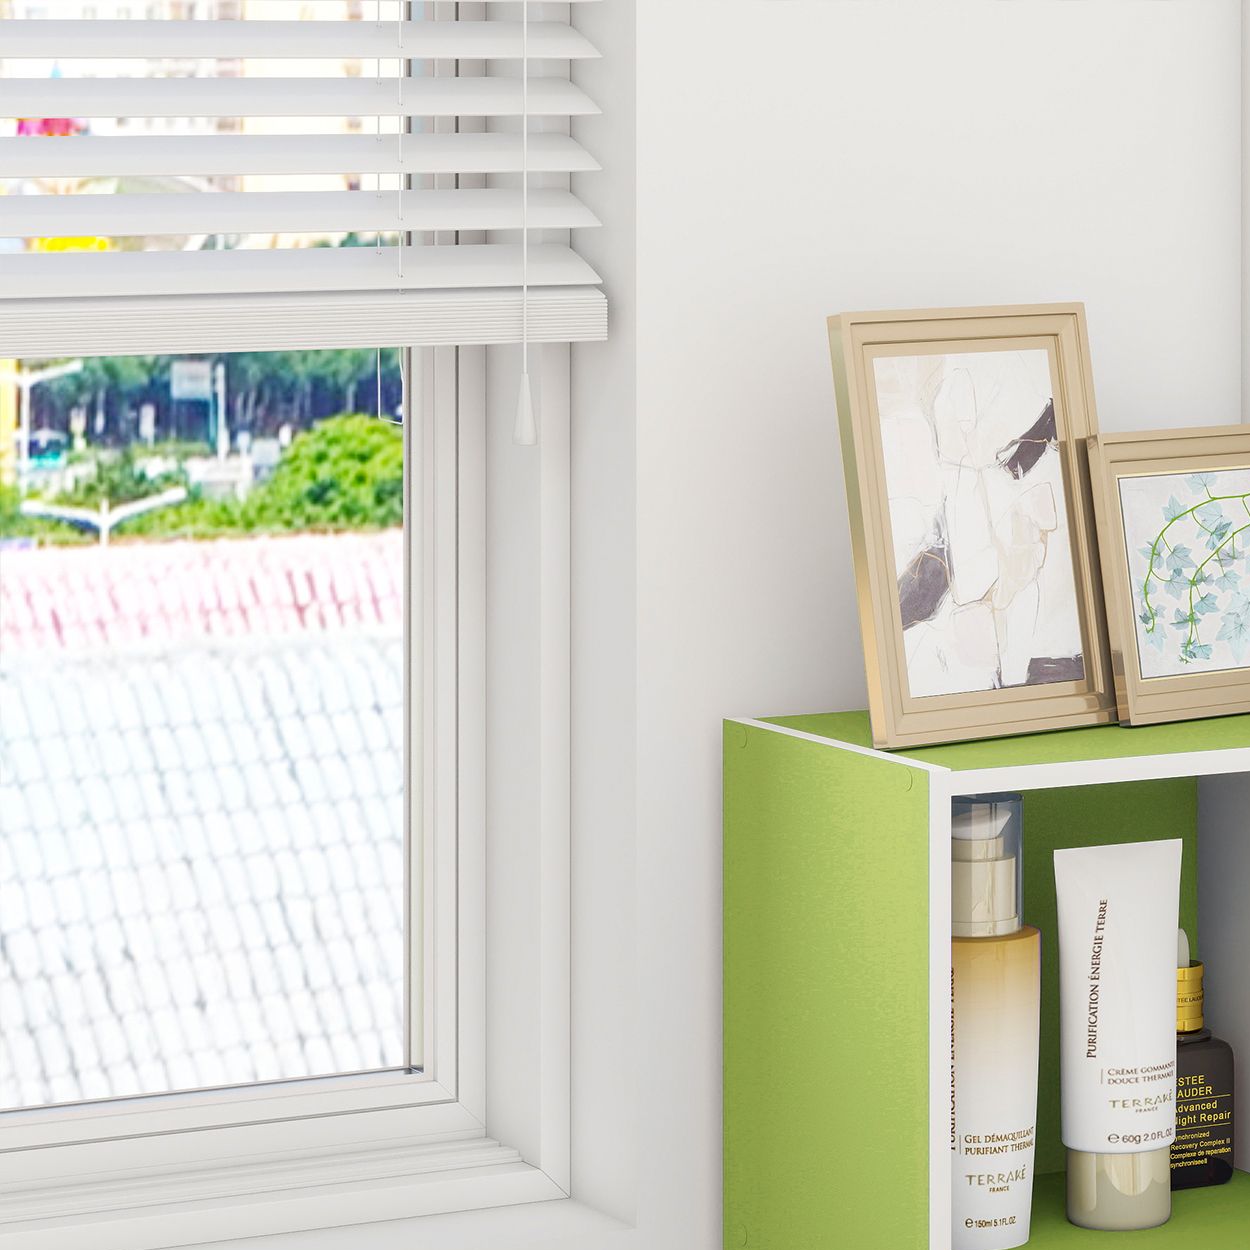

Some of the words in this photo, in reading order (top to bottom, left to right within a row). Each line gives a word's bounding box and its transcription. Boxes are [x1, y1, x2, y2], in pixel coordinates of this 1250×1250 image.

[1095, 899, 1108, 933] TERRE
[1088, 935, 1104, 980] ÉNERGIE
[1086, 984, 1099, 1058] PURIFICATION
[1107, 1077, 1139, 1085] DOUCE
[1176, 1075, 1205, 1087] STEE
[1177, 1086, 1213, 1098] AUDER
[1200, 1110, 1231, 1122] Repair
[964, 1135, 981, 1144] GEL
[1121, 1134, 1141, 1144] 60g
[1174, 1131, 1210, 1142] ynchronized
[1199, 1139, 1225, 1147] Complex
[964, 1145, 1008, 1155] PURIFIANT
[989, 1185, 1010, 1193] FRANCE
